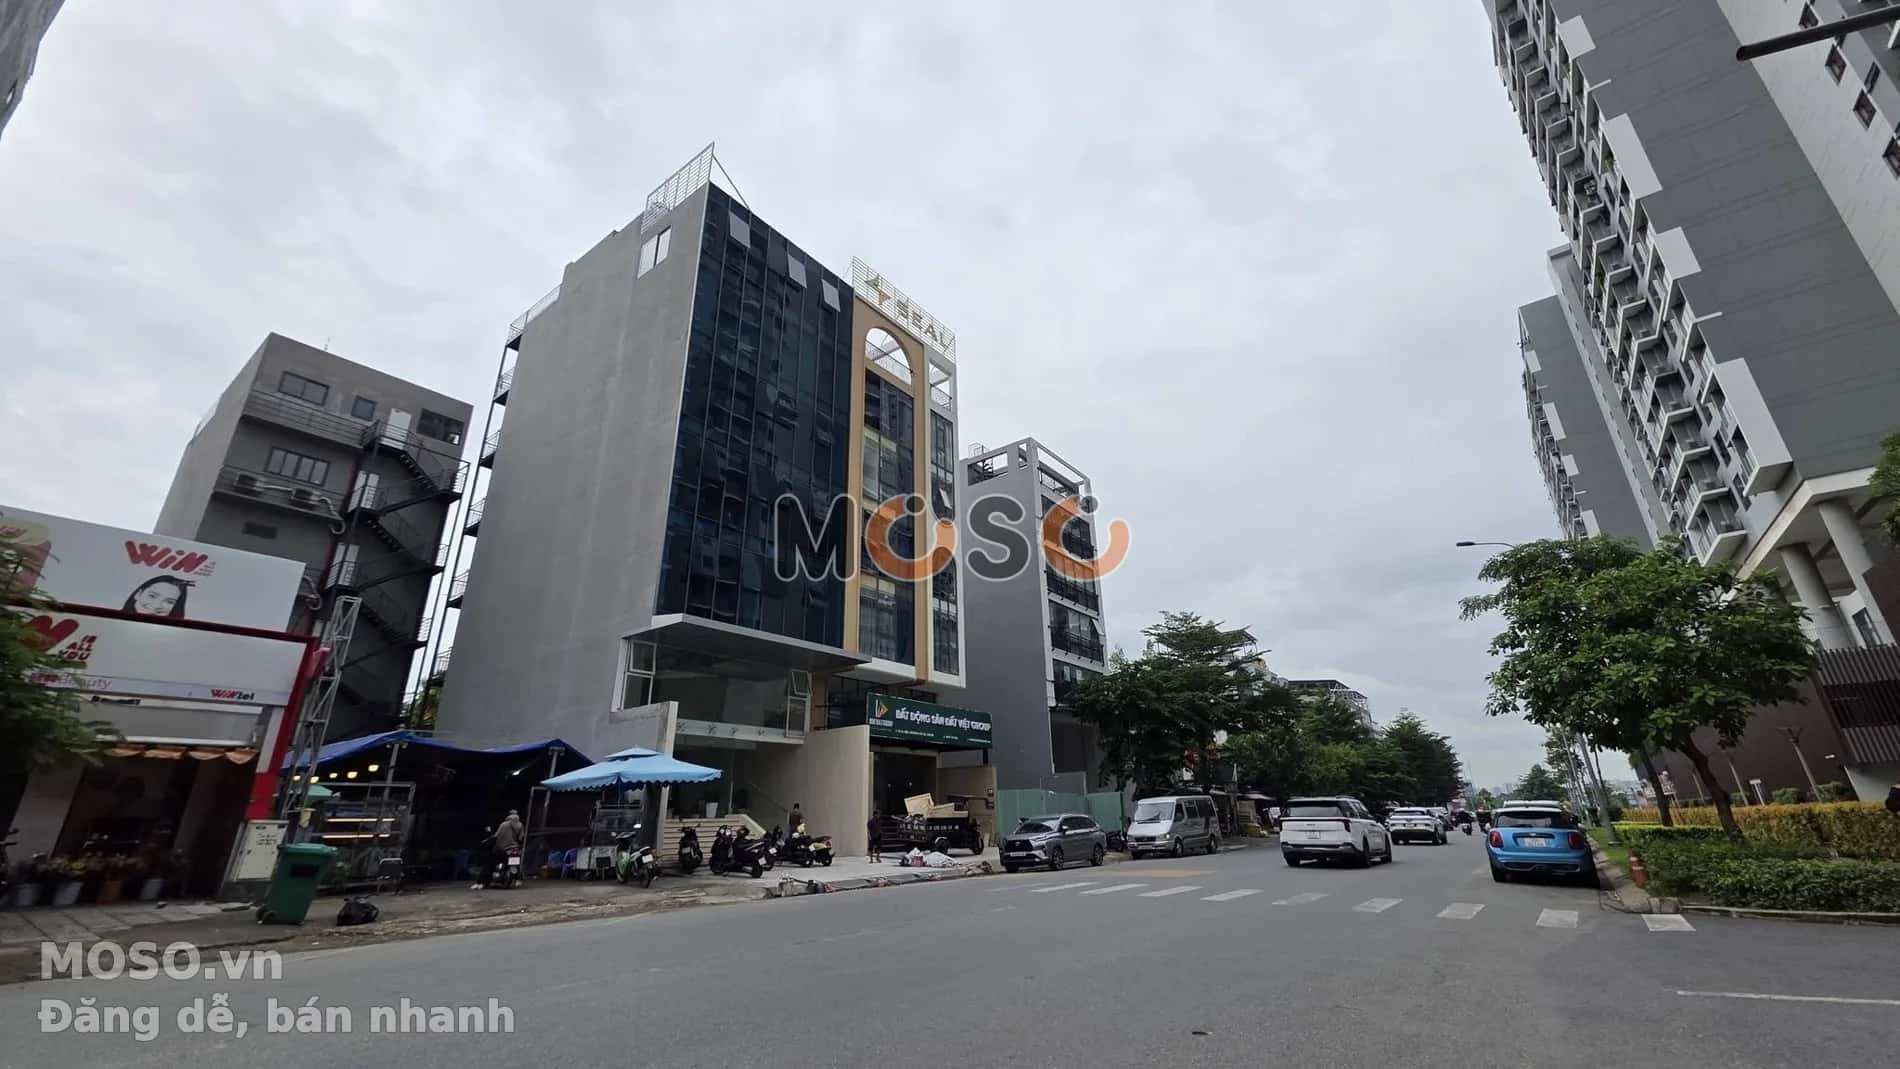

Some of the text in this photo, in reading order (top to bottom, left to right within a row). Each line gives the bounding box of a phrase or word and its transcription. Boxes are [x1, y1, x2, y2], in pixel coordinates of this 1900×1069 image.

[66, 642, 92, 651] ALL
[59, 650, 91, 660] YOU
[910, 711, 931, 724] ĐỘNG
[958, 717, 970, 731] VIỆT
[970, 721, 991, 731] GROUP
